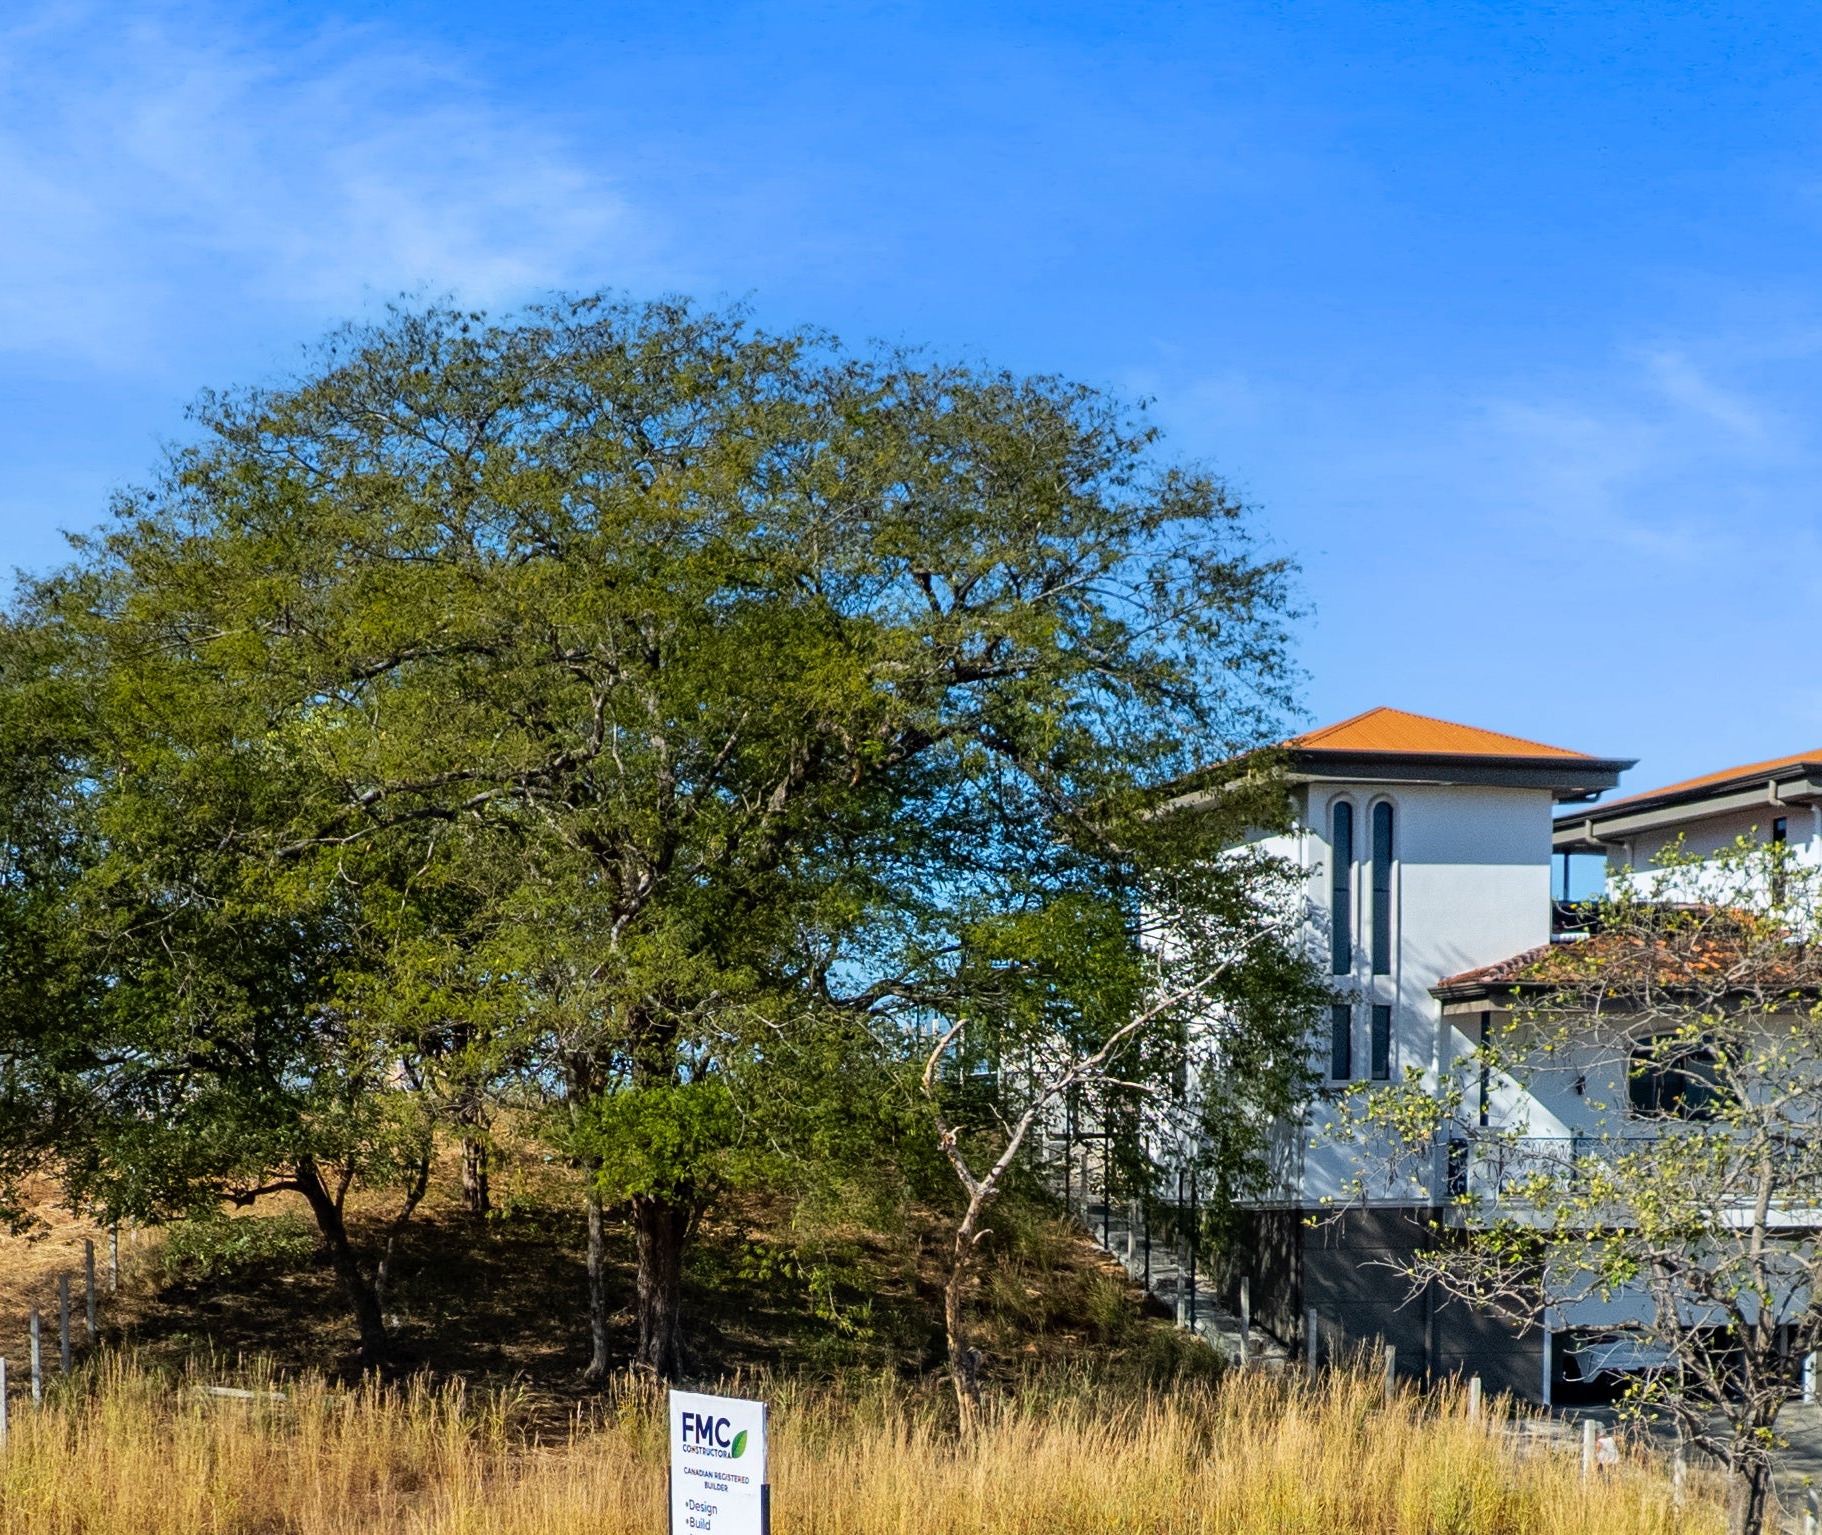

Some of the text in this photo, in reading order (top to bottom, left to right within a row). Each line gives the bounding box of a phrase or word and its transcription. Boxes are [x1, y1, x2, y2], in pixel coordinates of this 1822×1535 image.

[682, 1412, 731, 1448] FMC
[683, 1444, 732, 1459] CONSTRUCTORA
[684, 1467, 750, 1484] CANADIAN REGISTERED
[704, 1481, 728, 1492] BUILDER
[689, 1499, 717, 1516] Design
[689, 1517, 710, 1530] Build
